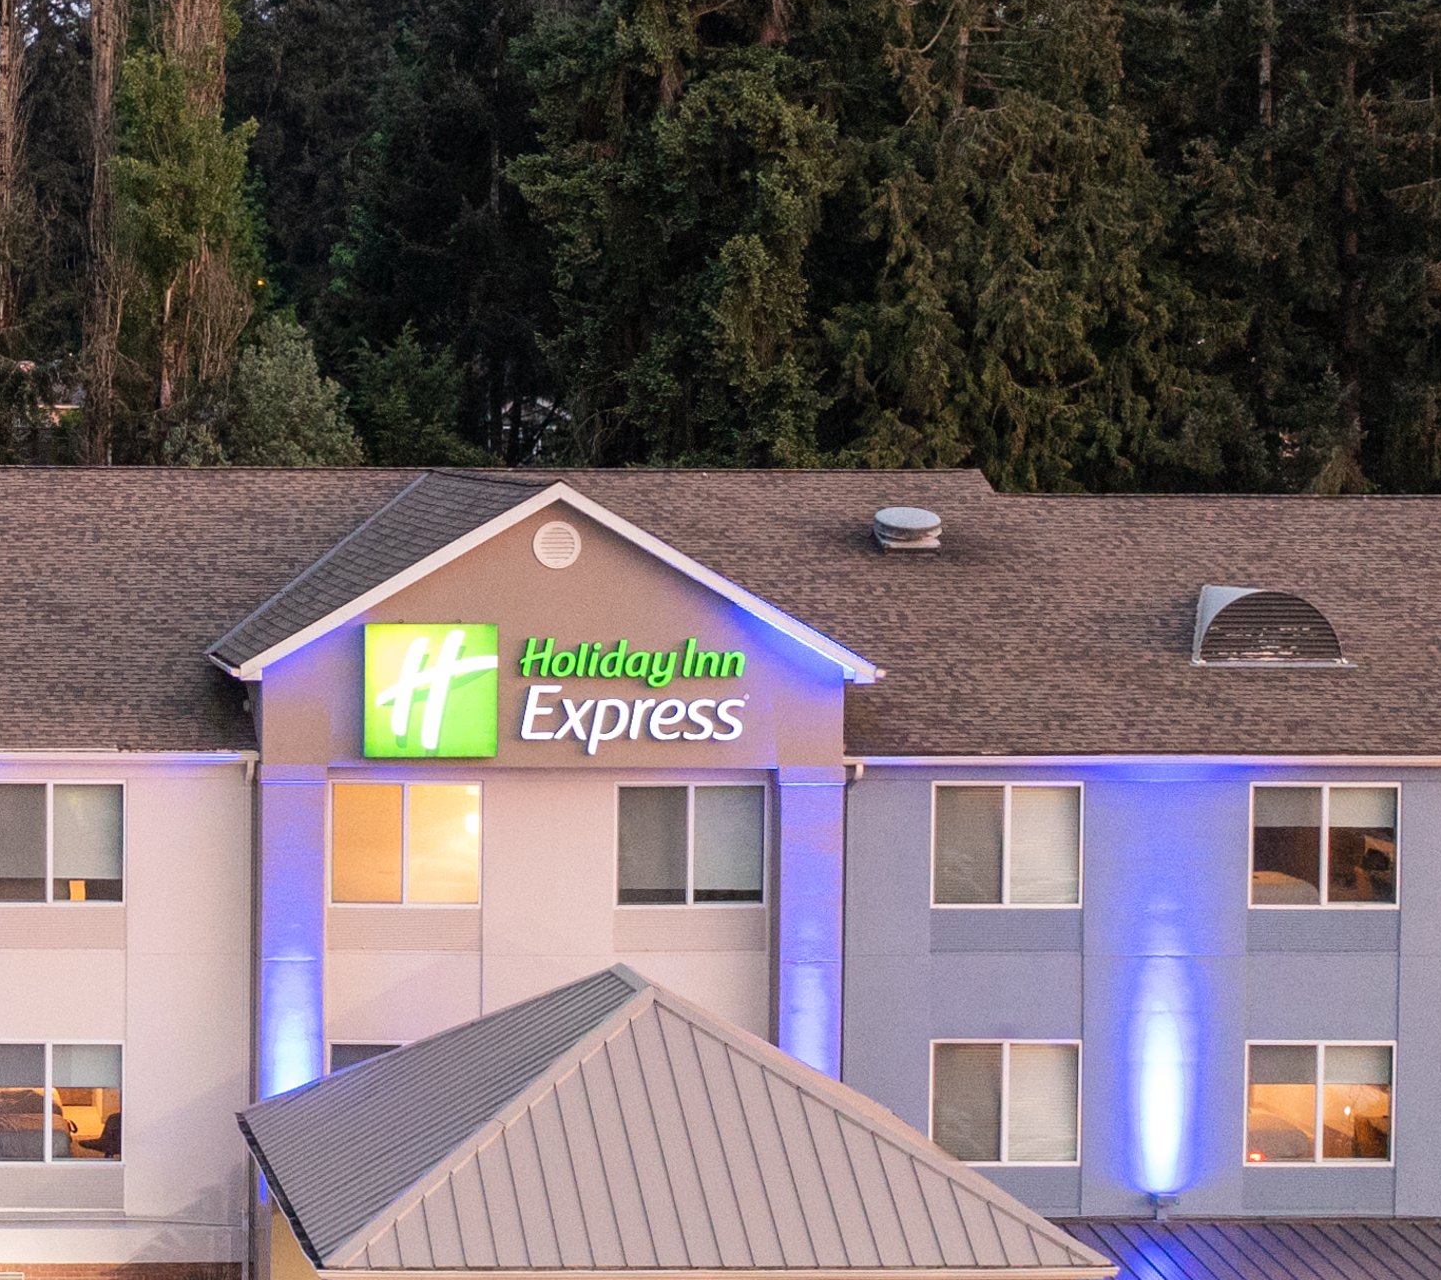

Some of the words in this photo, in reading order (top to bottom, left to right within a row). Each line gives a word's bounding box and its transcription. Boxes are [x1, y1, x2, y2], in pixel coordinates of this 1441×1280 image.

[520, 637, 678, 688] Holiday
[682, 637, 746, 678] Inn
[520, 684, 747, 756] Express
